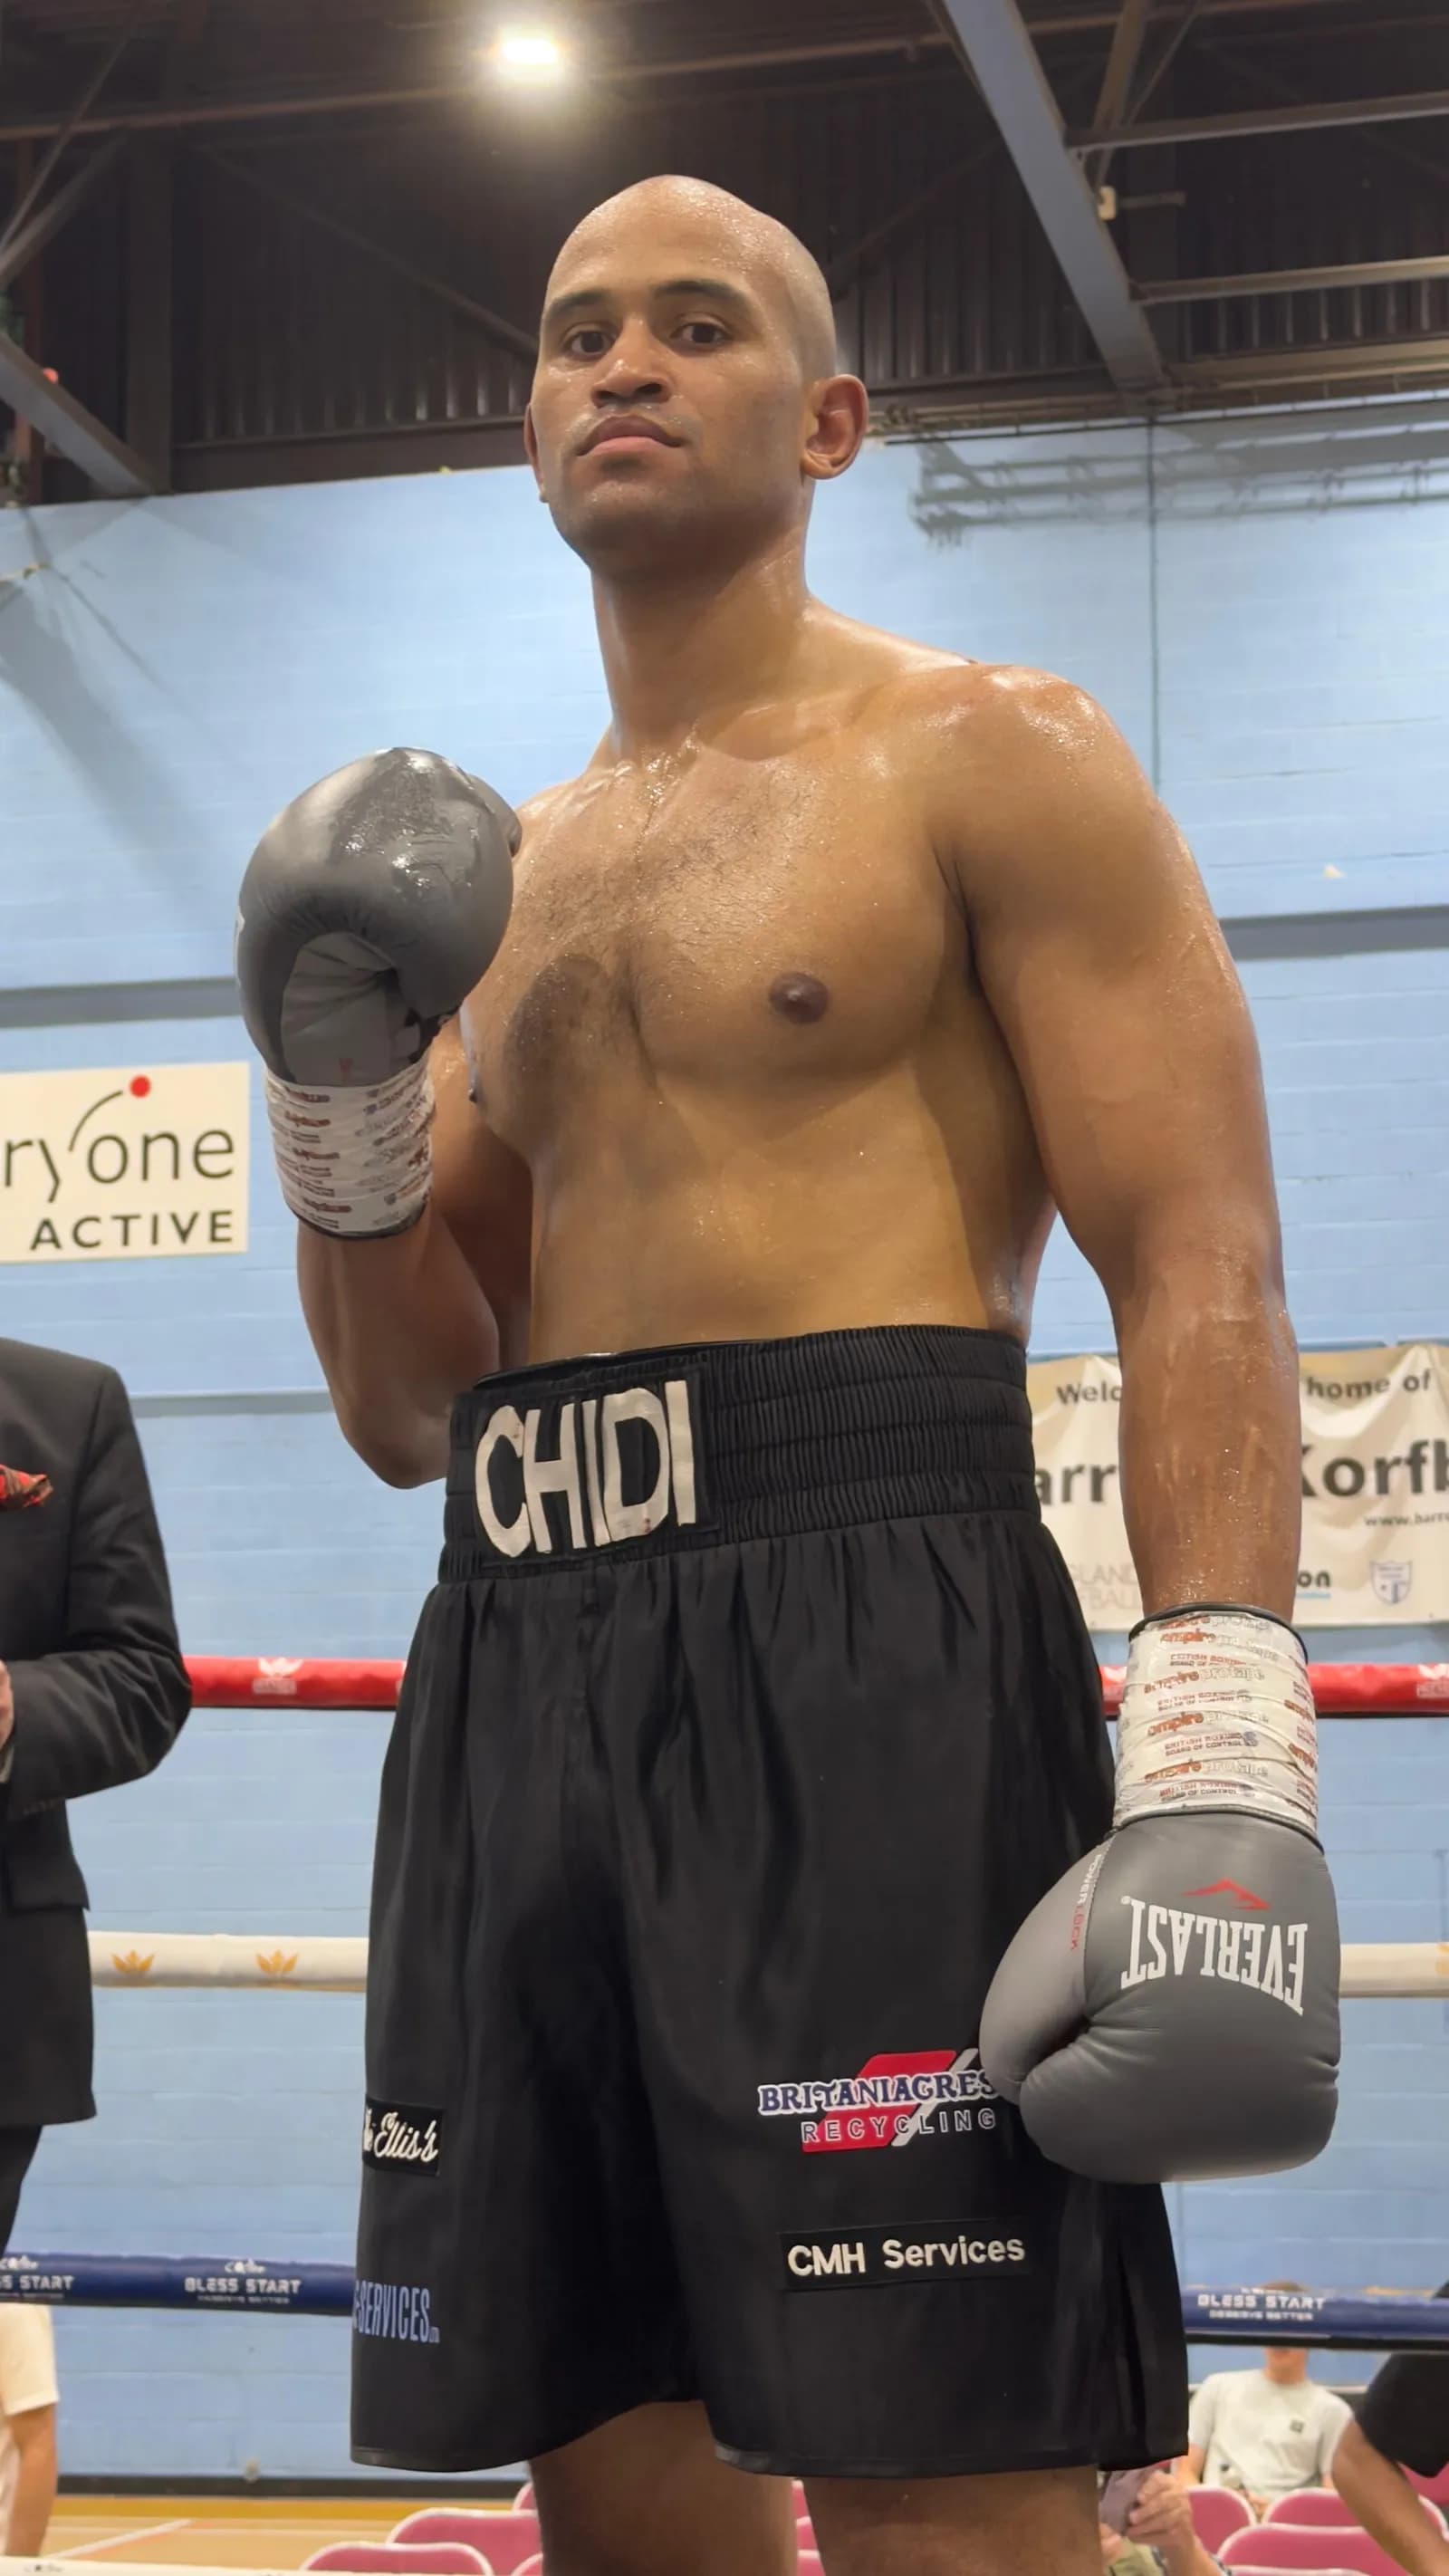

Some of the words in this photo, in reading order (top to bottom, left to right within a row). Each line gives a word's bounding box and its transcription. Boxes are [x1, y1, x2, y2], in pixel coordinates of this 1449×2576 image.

[30, 1211, 233, 1251] ACTIVE
[1307, 1376, 1389, 1400] home
[1403, 1370, 1431, 1391] of
[475, 1380, 696, 1558] CHIDI
[1120, 1897, 1309, 2016] EVERLAST
[373, 2111, 438, 2163] Ellis's
[801, 2108, 995, 2144] RECYCLING
[787, 2242, 866, 2276] CMH
[882, 2235, 1025, 2270] Services
[19, 2274, 74, 2291] START
[185, 2276, 238, 2292] BLESS
[245, 2278, 302, 2294] START
[1197, 2294, 1256, 2308] BLESS
[1265, 2294, 1326, 2311] START
[359, 2281, 430, 2343] SERVICES
